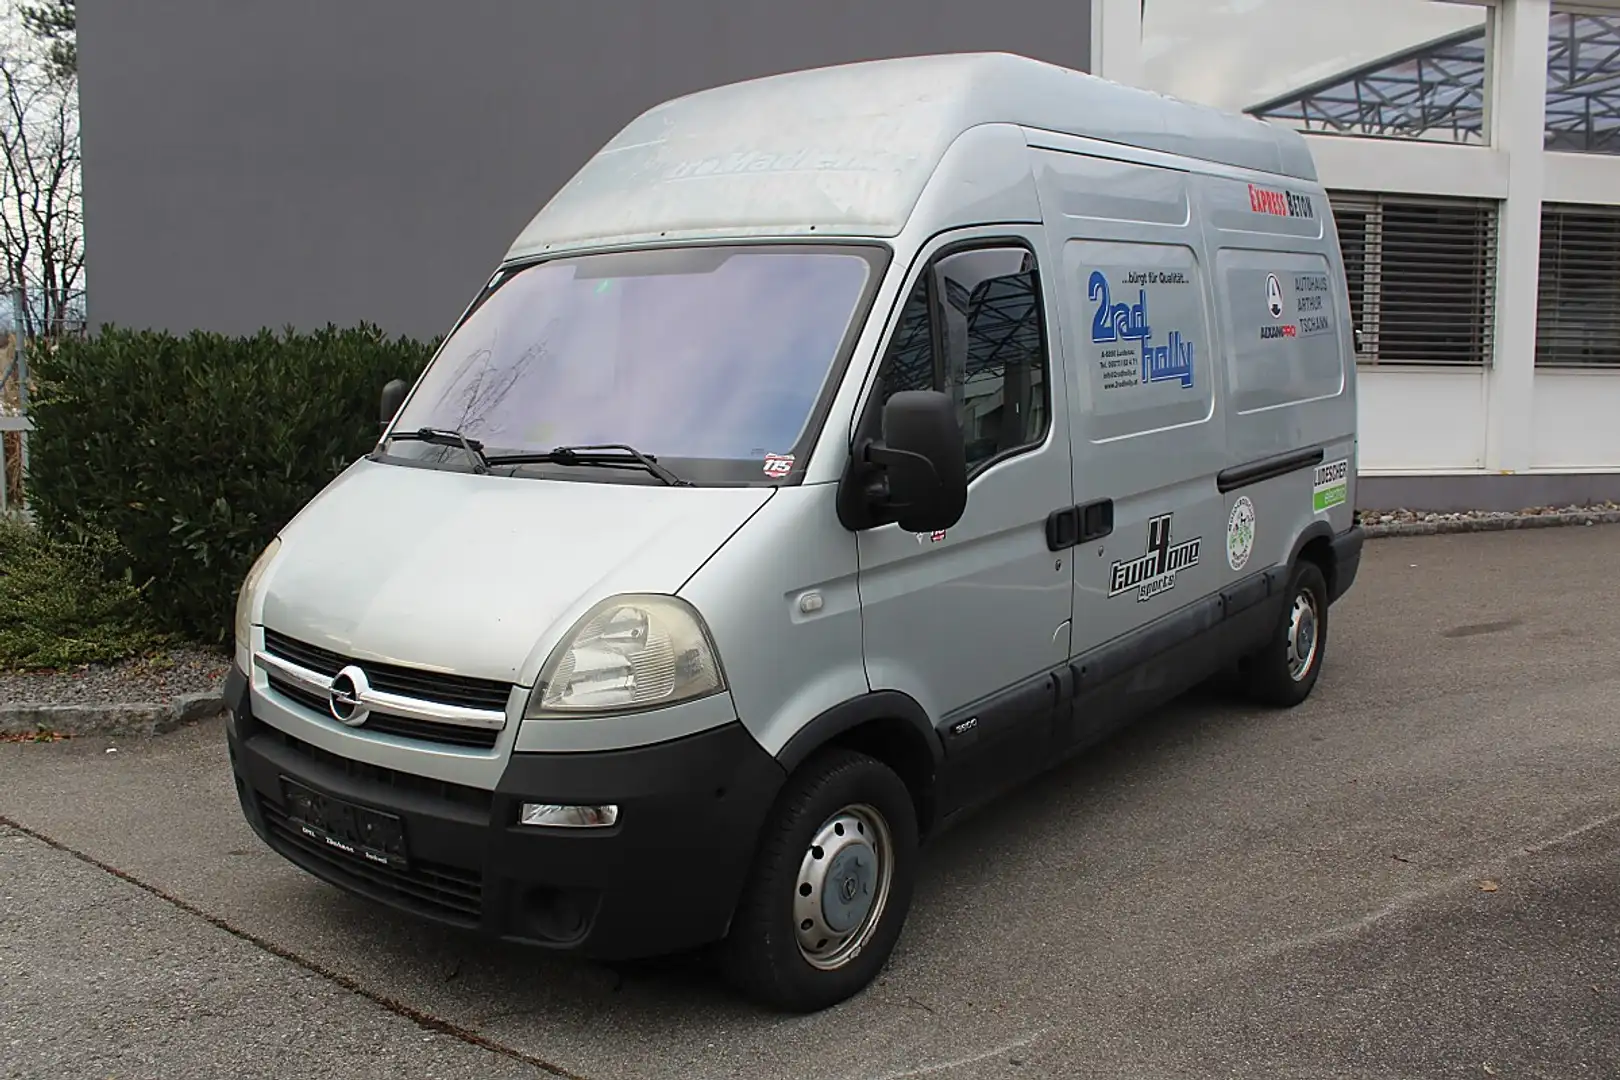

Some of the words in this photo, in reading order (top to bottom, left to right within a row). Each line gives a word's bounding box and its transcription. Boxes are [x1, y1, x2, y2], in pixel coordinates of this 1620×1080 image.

[1295, 276, 1328, 292] AUTOHAUS
[1088, 271, 1151, 343] 2rad
[1298, 296, 1322, 312] ARTHUR
[1299, 316, 1329, 333] TSCHANN
[1140, 575, 1175, 597] sports
